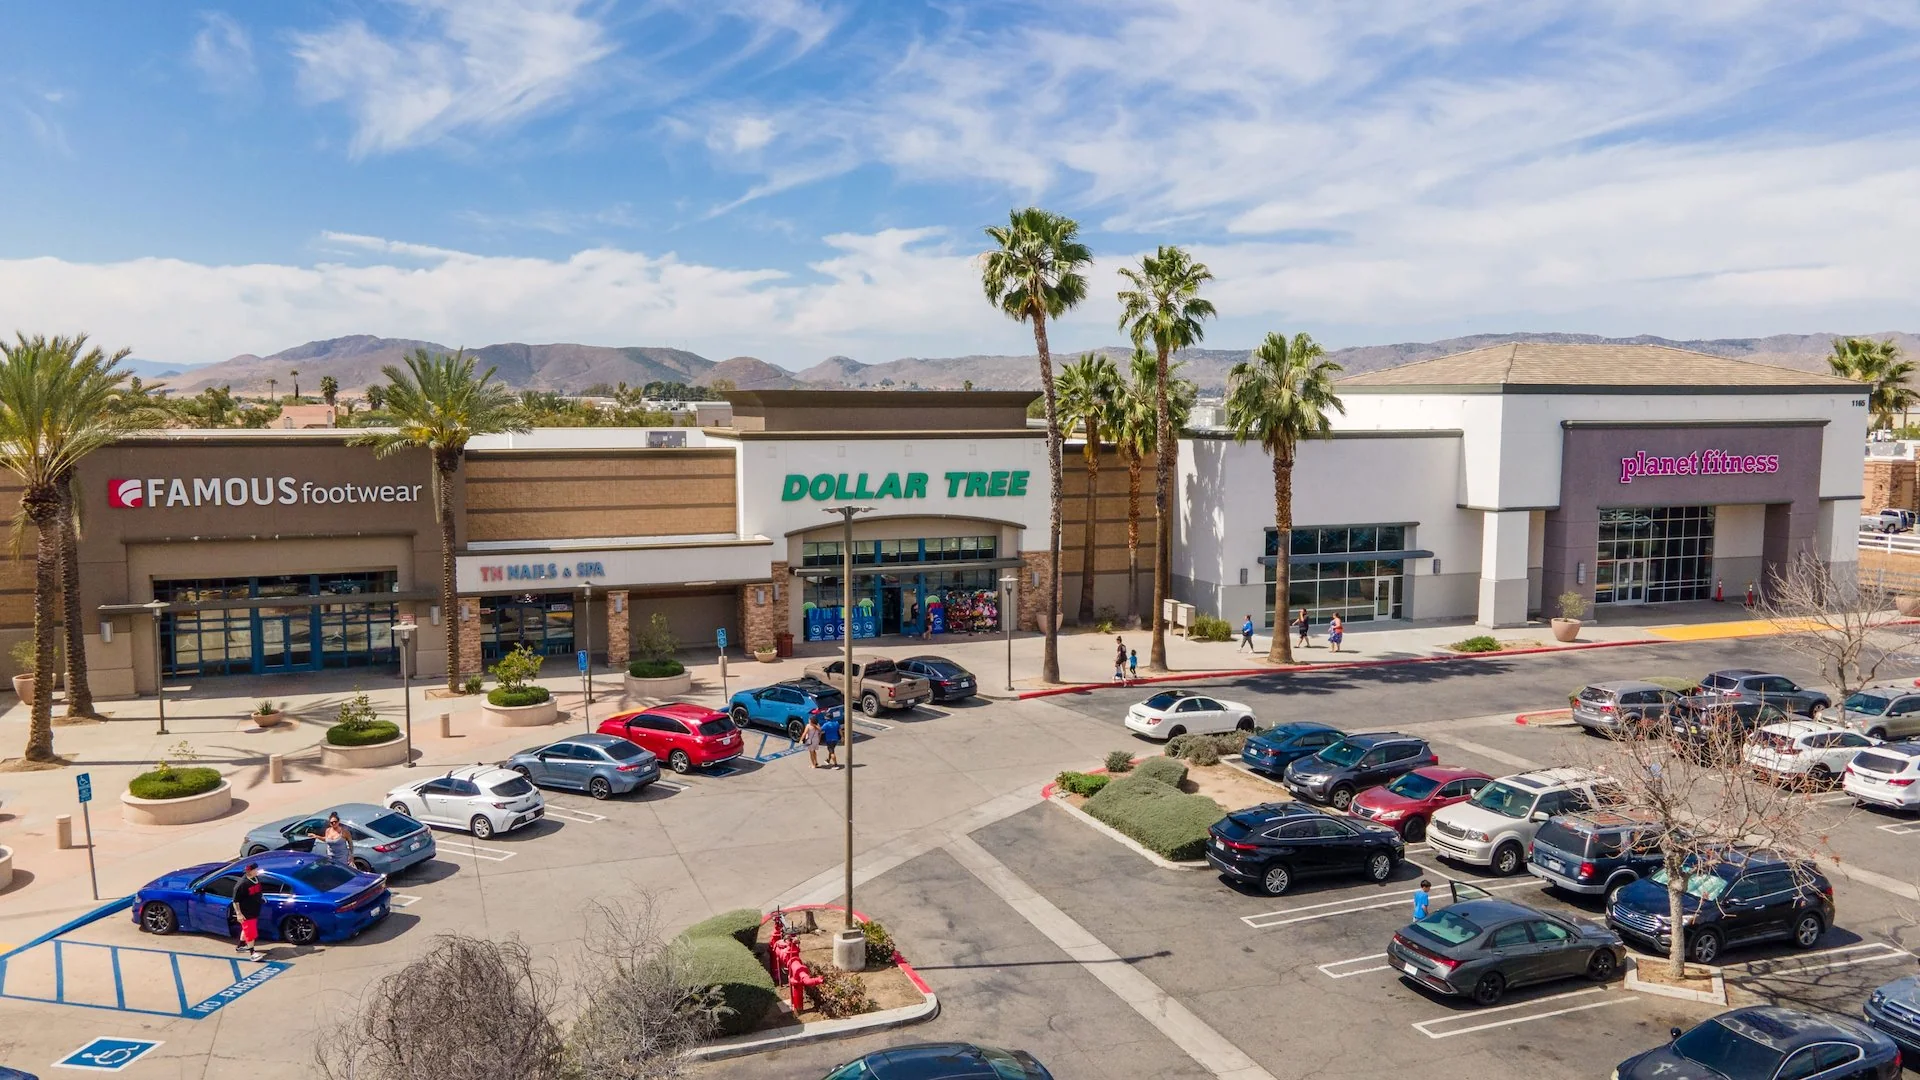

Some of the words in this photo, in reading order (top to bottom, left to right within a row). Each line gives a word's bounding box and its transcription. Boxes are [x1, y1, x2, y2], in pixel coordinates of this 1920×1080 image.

[1620, 450, 1699, 484] planet
[1701, 449, 1779, 475] fitness
[147, 476, 298, 507] FAMOUS
[301, 481, 423, 504] footwear
[781, 472, 929, 501] DOLLAR
[944, 470, 1030, 498] TREE
[480, 564, 503, 582] TN
[507, 563, 558, 581] NAILS
[562, 567, 572, 579] &
[577, 561, 606, 578] SPA
[192, 1000, 222, 1013] NO
[219, 967, 281, 998] PARKING
